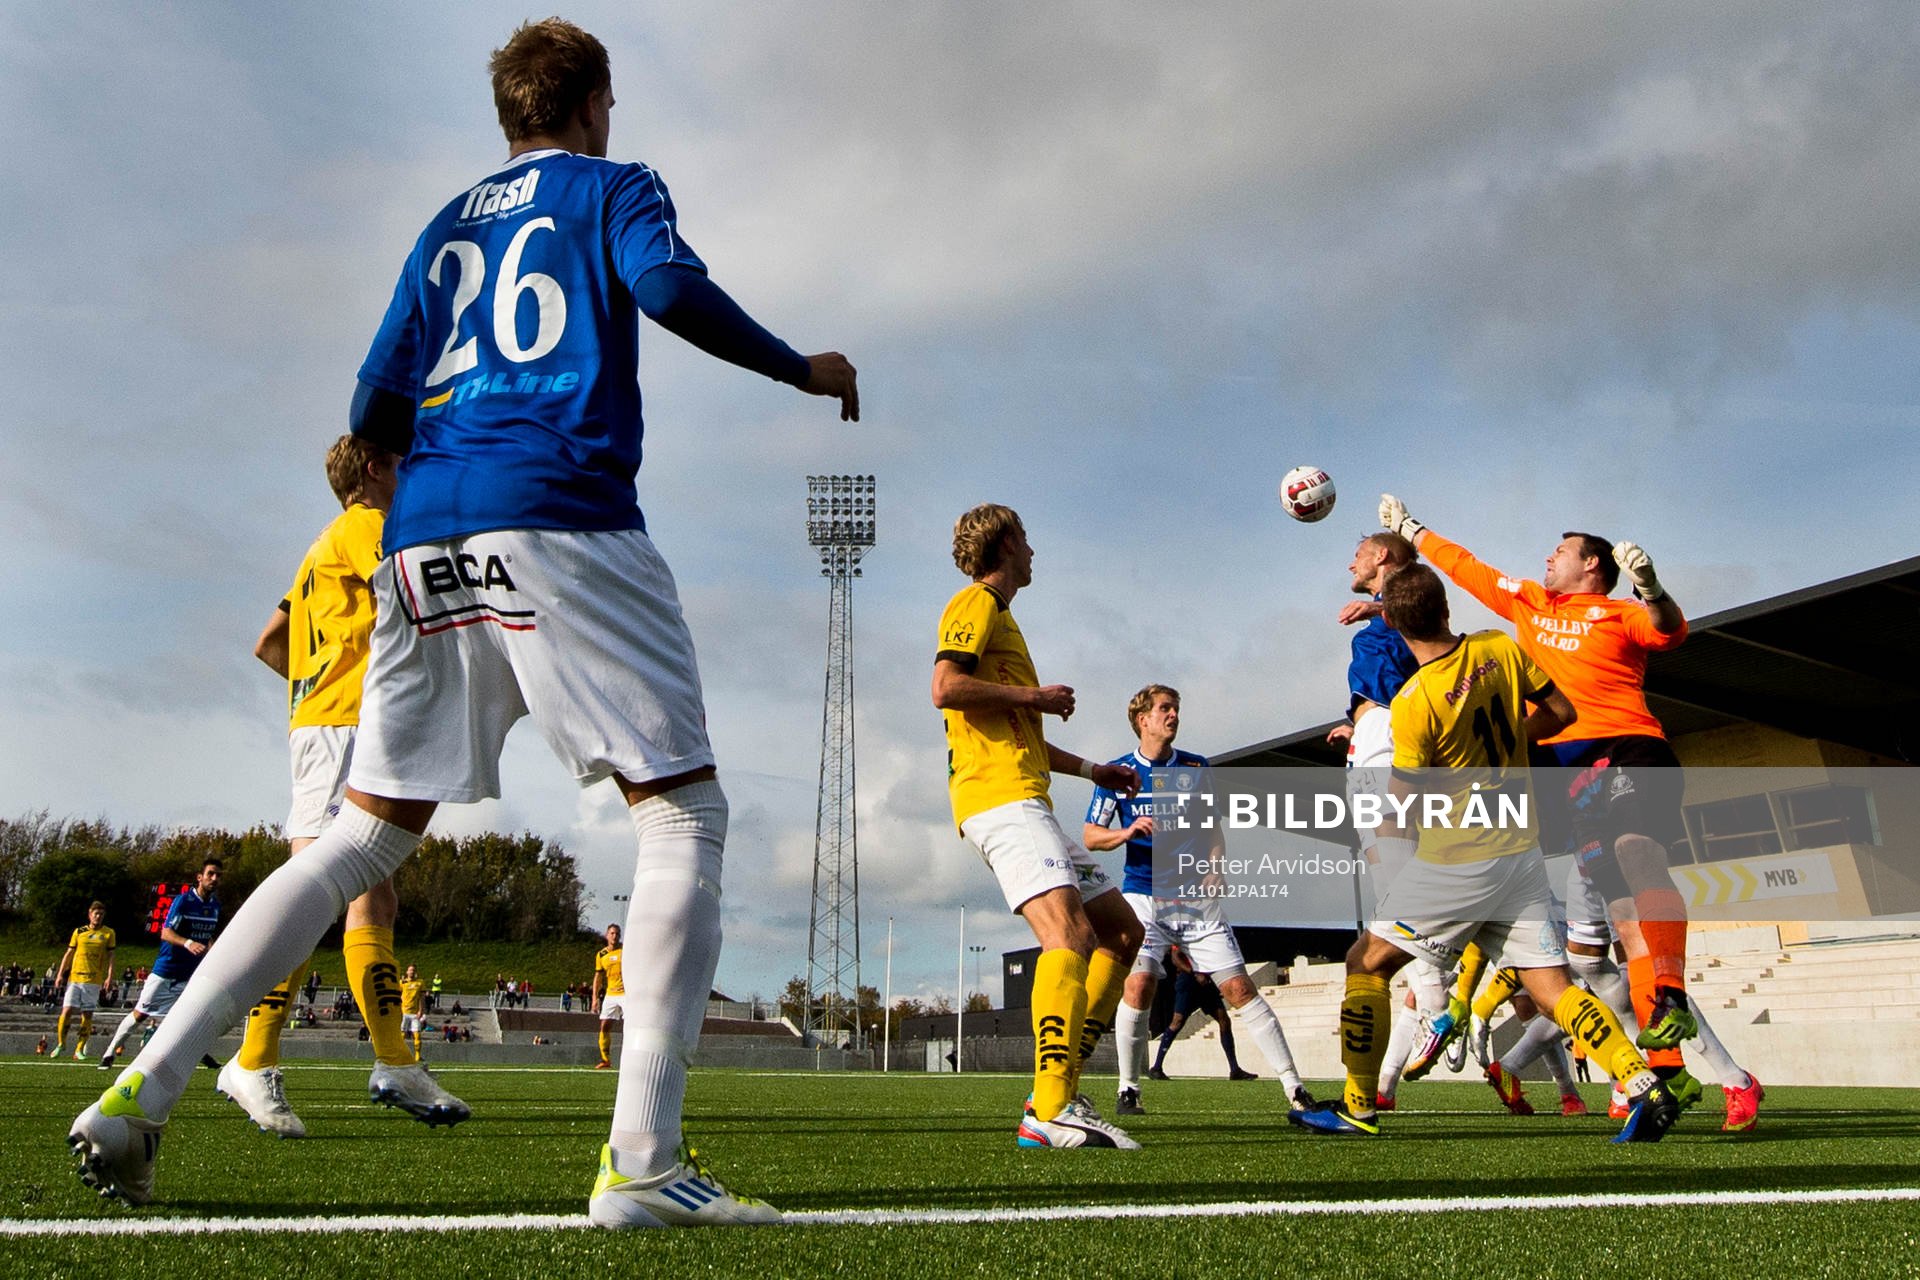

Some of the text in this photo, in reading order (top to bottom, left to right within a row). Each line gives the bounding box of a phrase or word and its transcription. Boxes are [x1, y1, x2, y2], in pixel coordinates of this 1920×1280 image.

[425, 216, 567, 388] 26
[420, 553, 517, 596] BCA
[944, 631, 976, 644] LKF
[1472, 692, 1517, 785] 11
[1763, 868, 1798, 888] MVB
